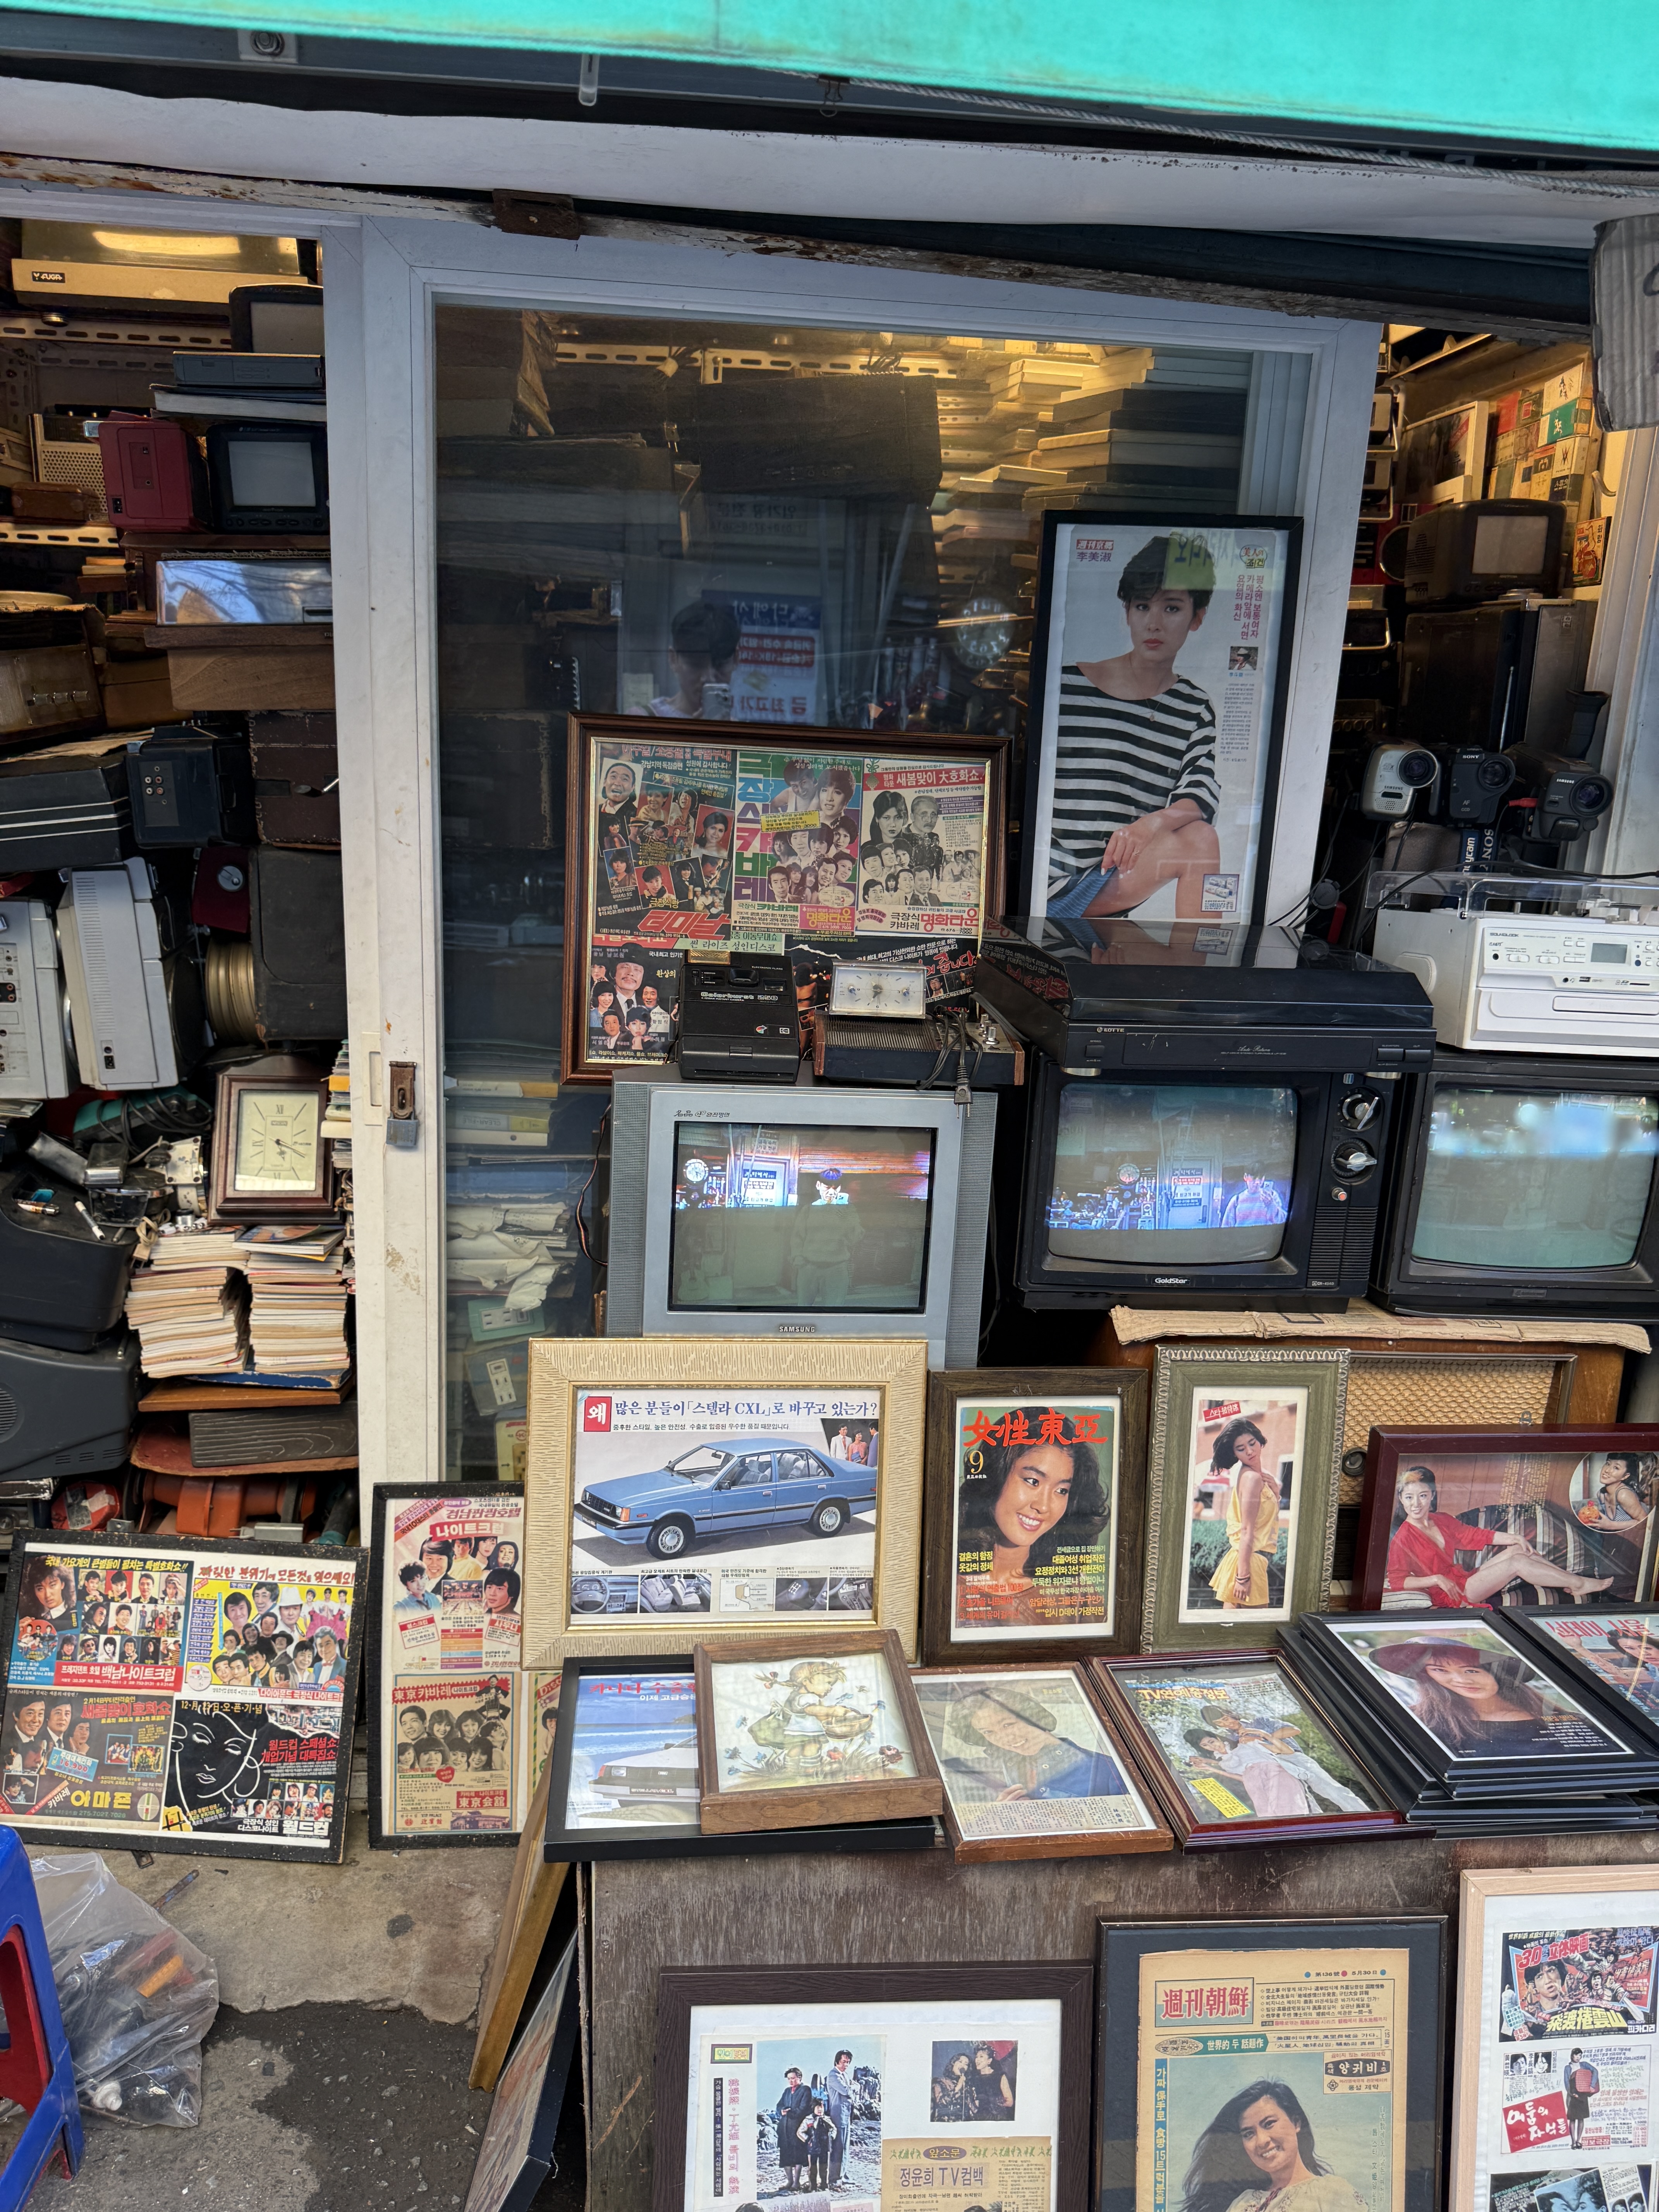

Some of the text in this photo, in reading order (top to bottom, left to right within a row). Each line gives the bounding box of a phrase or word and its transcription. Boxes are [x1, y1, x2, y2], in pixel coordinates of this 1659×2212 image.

[1255, 575, 1264, 601] 평소엔
[1234, 575, 1245, 621] 요염의 화신
[1241, 575, 1255, 640] 카메라앞에 서면
[641, 761, 661, 769] 강남지역
[662, 762, 683, 770] 독점출연
[896, 771, 936, 787] 새봄맞이
[650, 898, 679, 909] 극장식당
[757, 903, 799, 912] 캬바레
[807, 908, 852, 927] 명화타운
[890, 908, 979, 932] 극장식 명화타운
[890, 922, 919, 931] 캬바레
[743, 932, 778, 941] 이동무대쇼
[690, 940, 776, 951] 썬 라이즈 성인디스코
[892, 945, 916, 956] 기상천외한
[926, 939, 946, 949] 전문으로
[924, 948, 939, 956] 영동에
[656, 969, 676, 978] 환상의
[587, 1402, 607, 1425] 왜
[615, 1401, 878, 1417] 많은 바꾸고 있는가?
[962, 1407, 1108, 1447] 女性東亞
[969, 1450, 984, 1474] 9
[446, 1507, 522, 1519] 경남관광호텔
[436, 1522, 503, 1537] 나이트크럽
[45, 1554, 144, 1571] 국내 가요계의 큰별들이 펼치는
[958, 1551, 993, 1561] 결혼의 함정
[1052, 1554, 1105, 1564] 대졸여성 취업작전
[958, 1561, 993, 1572] 옷값의 정체
[1035, 1564, 1105, 1575] 요정정치와 3선 개헌전야
[198, 1565, 311, 1582] 짜릿한 분위기에 모든것을
[1032, 1575, 1105, 1587] 두둑한 위자료냐 형벌이냐
[987, 1584, 1006, 1593] 연출법
[1029, 1594, 1104, 1607] 암달러상, 그들은 누구인가
[966, 1610, 1000, 1620] 세계의 유머
[1045, 1606, 1104, 1617] 입시 D데이 가정작전
[494, 1621, 519, 1632] 사우나
[1545, 1620, 1611, 1638] 선데이
[61, 1665, 88, 1674] 프레지덴트
[89, 1665, 100, 1674] 호텔
[101, 1665, 176, 1681] 백남나이트크럽
[260, 1689, 292, 1698] 다이아몬드
[293, 1691, 313, 1700] 극장식
[393, 1685, 452, 1701] 東京캬바레
[588, 1682, 642, 1695] 카나다
[1137, 1686, 1230, 1701] TV연예총정보
[132, 1701, 171, 1716] 호화쇼
[269, 1739, 297, 1751] 월드컵
[261, 1751, 297, 1763] 개업기념
[48, 1787, 71, 1809] 캬바레
[71, 1791, 132, 1809] 아마존
[459, 1796, 505, 1808] 東京会館
[237, 1825, 279, 1833] 디스코나이트
[282, 1820, 329, 1836] 월드컵
[1161, 1987, 1249, 2020] 週刊朝鮮
[1627, 2024, 1656, 2034] 피카디리
[1207, 2040, 1230, 2051] 世界的
[1231, 2039, 1239, 2050] 두
[1339, 2061, 1377, 2075] 양귀비
[1156, 2068, 1166, 2088] 가짜
[1507, 2101, 1549, 2126] 어둠의
[1527, 2118, 1570, 2141] 자식들
[929, 2148, 960, 2158] 앞소문
[900, 2167, 934, 2188] 정윤희
